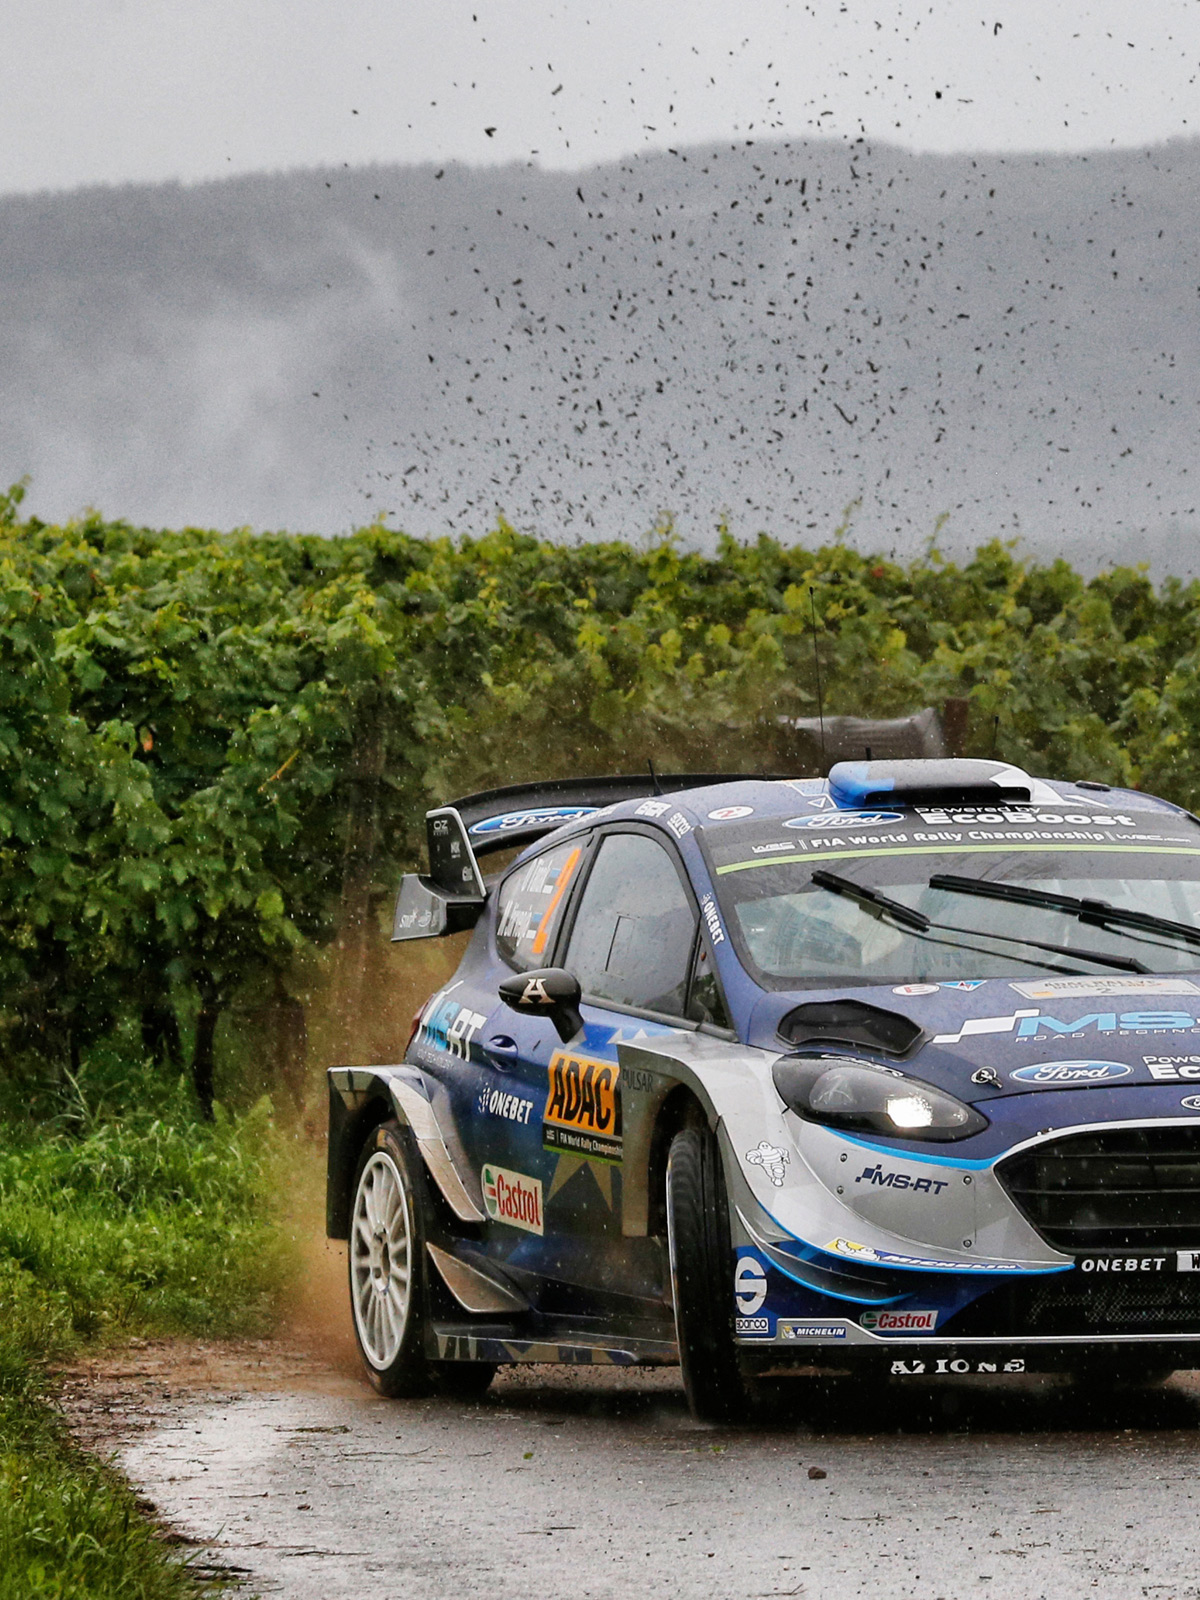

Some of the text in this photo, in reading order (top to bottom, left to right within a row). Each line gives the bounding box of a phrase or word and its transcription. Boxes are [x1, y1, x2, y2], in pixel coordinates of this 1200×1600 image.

[1015, 806, 1041, 815] by
[500, 811, 584, 830] Ford
[805, 811, 886, 828] Ford
[919, 812, 1137, 827] EcoBoost
[810, 836, 846, 849] FIA
[848, 832, 908, 846] World
[912, 830, 963, 843] Rally
[968, 830, 1105, 842] Championship
[703, 901, 725, 945] ONEBET
[1015, 1032, 1086, 1043] ROAD
[1032, 1061, 1112, 1083] Ford
[548, 1058, 613, 1130] ADAC
[488, 1090, 534, 1125] ONEBET
[496, 1173, 542, 1227] Castrol
[882, 1255, 1017, 1270] MICHELIN
[1080, 1257, 1166, 1273] ONEBET
[878, 1313, 932, 1329] Castrol
[796, 1327, 846, 1336] MICHELIN
